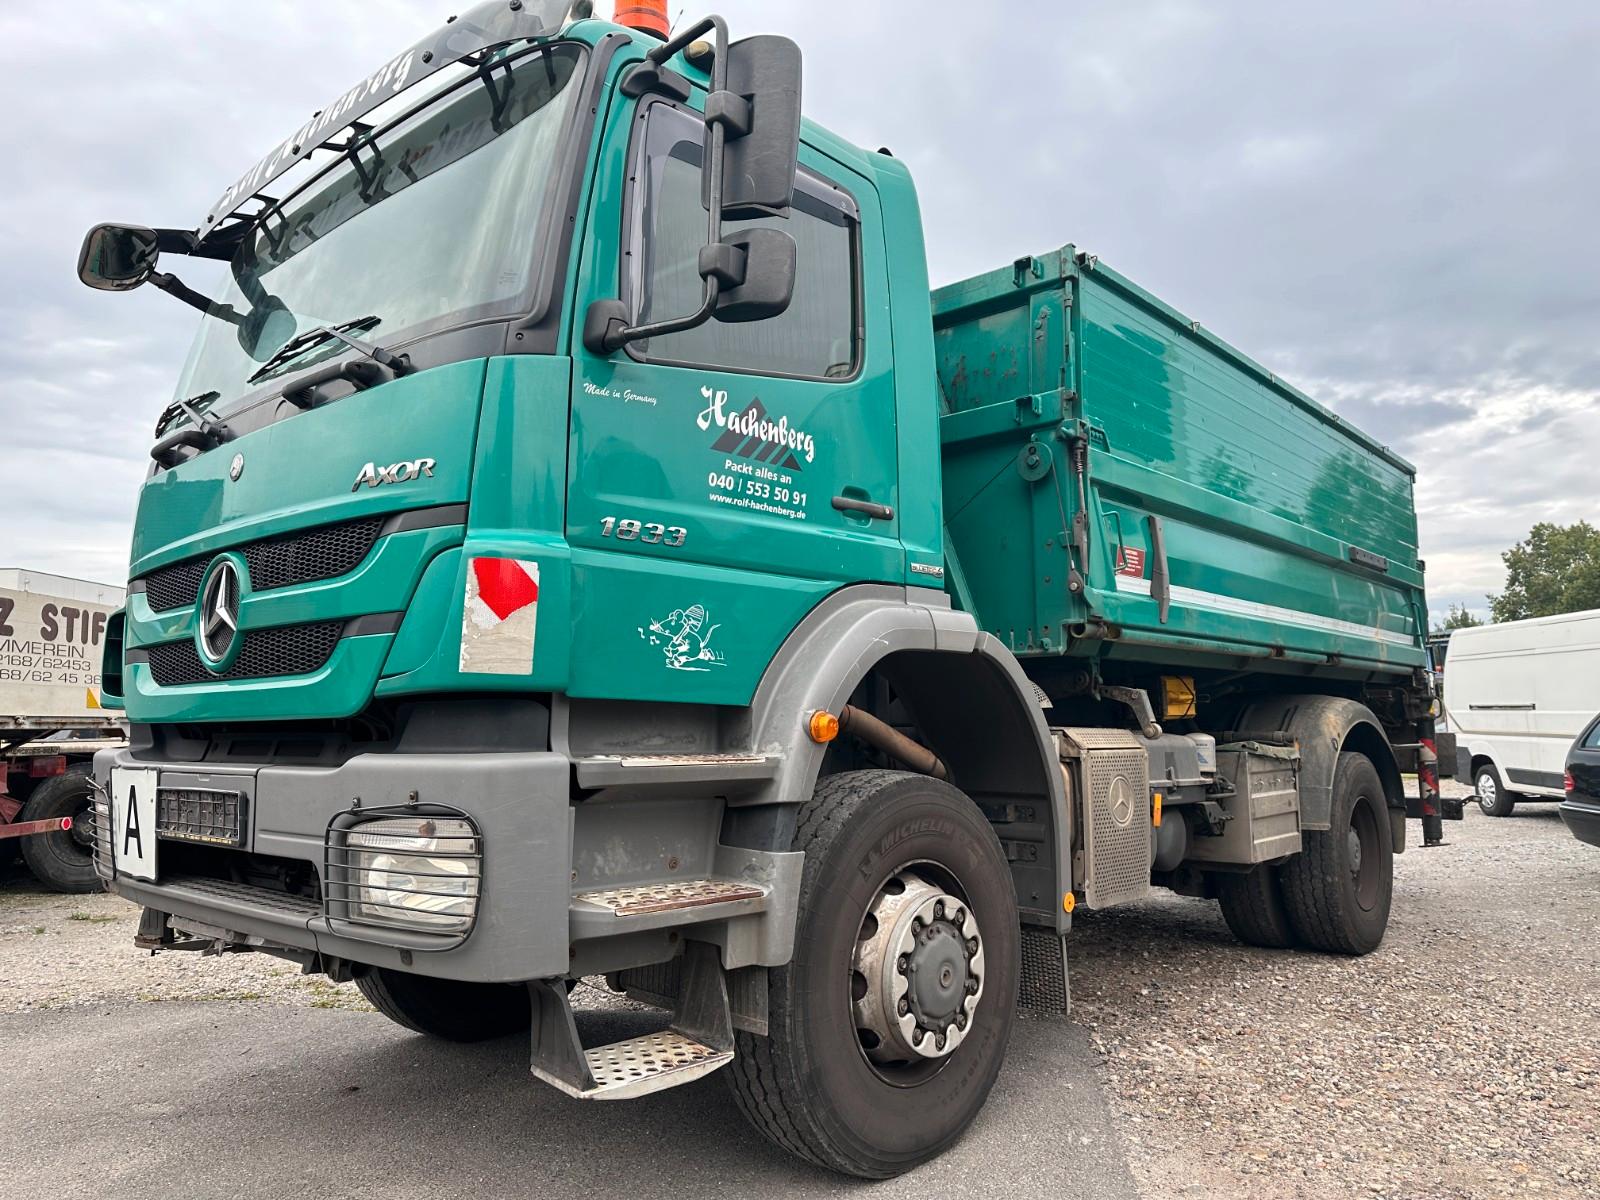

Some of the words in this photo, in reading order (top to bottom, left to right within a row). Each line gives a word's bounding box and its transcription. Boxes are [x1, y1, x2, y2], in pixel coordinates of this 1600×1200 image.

[583, 382, 611, 398] Made
[612, 389, 621, 398] in
[623, 389, 657, 406] Germany
[696, 385, 815, 464] Hachenberg
[351, 457, 437, 493] AXOR
[724, 459, 753, 475] Packt
[755, 467, 778, 481] alles
[780, 475, 792, 485] an
[708, 472, 735, 491] 040
[745, 480, 771, 499] 553
[773, 486, 789, 503] 50
[792, 491, 807, 507] 91
[709, 493, 807, 520] www.rolf-hachenberg.de
[599, 516, 688, 547] 1833
[58, 672, 78, 684] 45
[124, 785, 143, 859] A
[881, 816, 955, 854] MICHELIN
